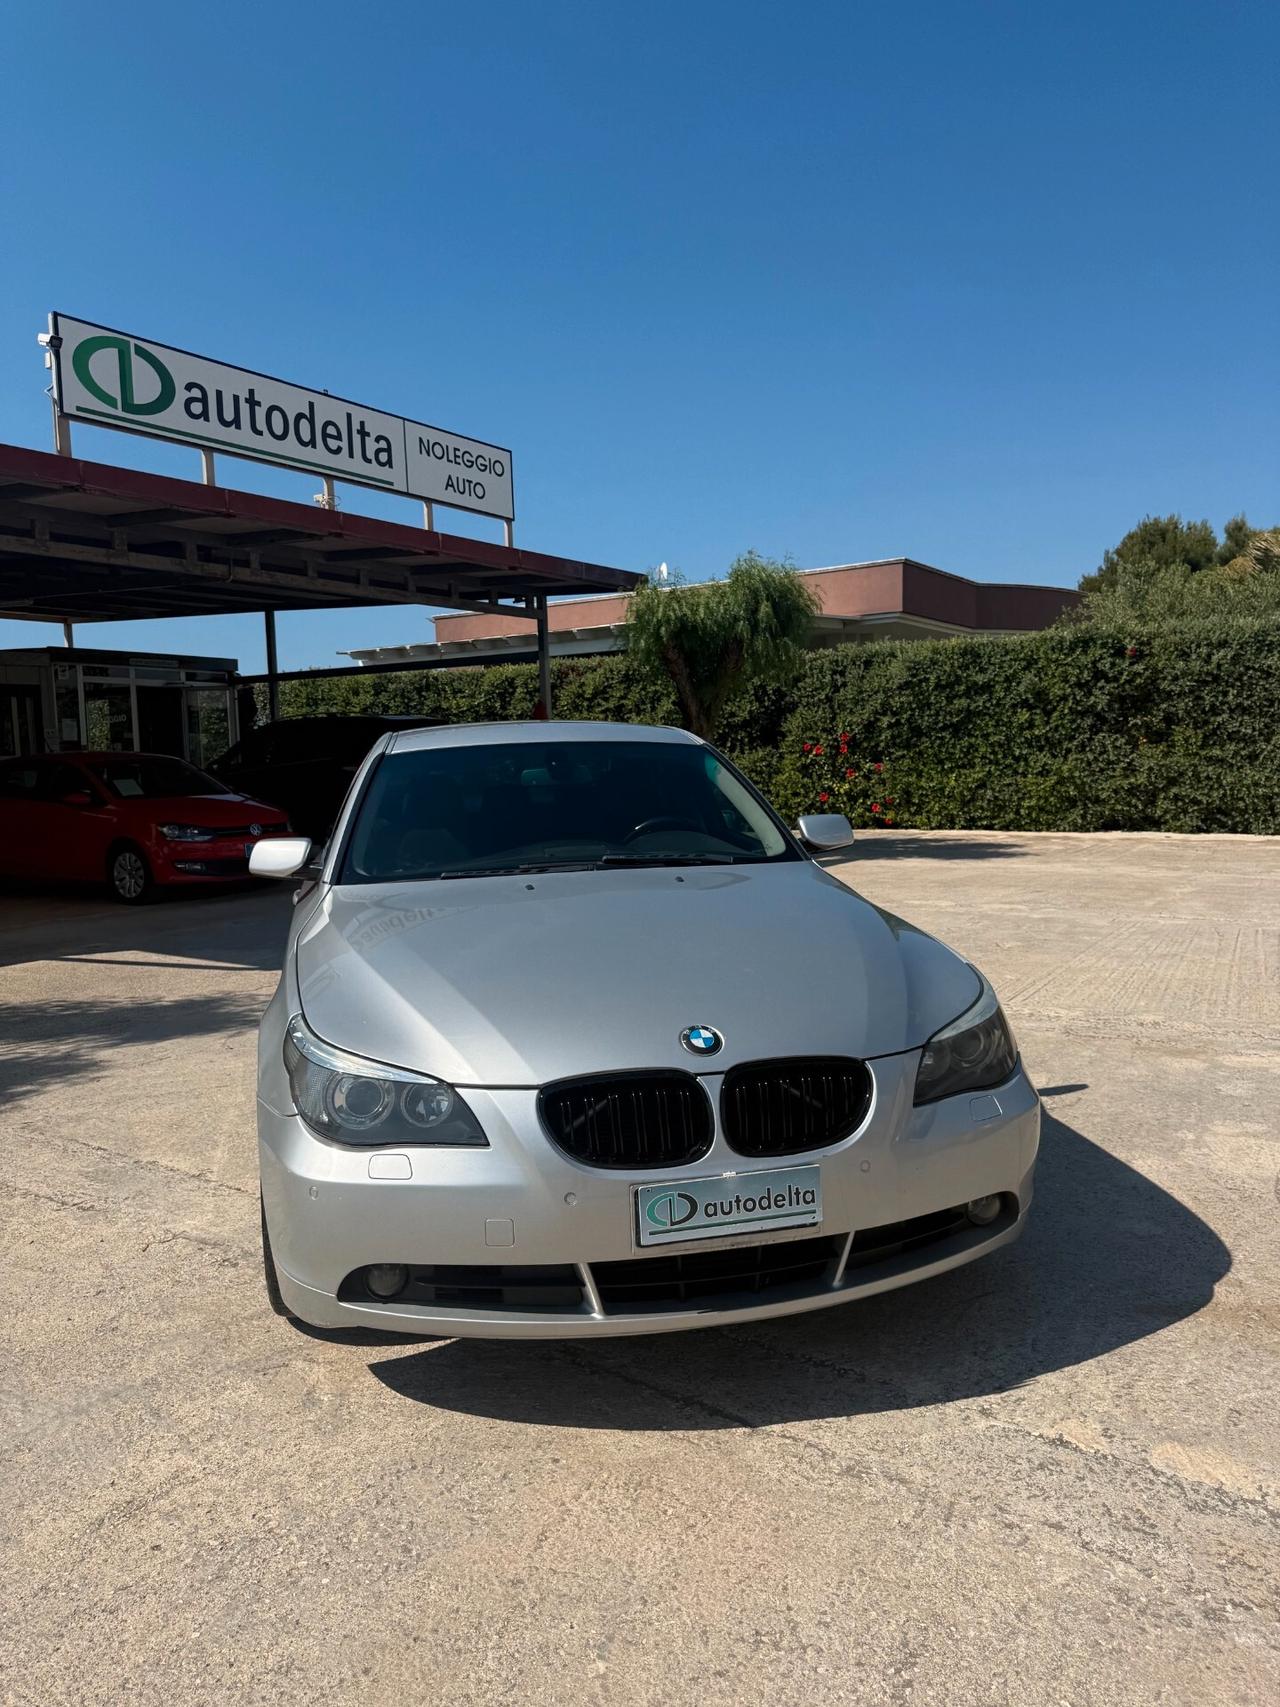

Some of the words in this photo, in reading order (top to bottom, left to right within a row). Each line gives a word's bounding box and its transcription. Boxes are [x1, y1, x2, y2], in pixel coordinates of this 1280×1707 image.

[183, 381, 394, 469] autodelta
[418, 436, 505, 477] NOLEGGIO
[445, 474, 486, 500] AUTO
[704, 1184, 816, 1218] autodelta
